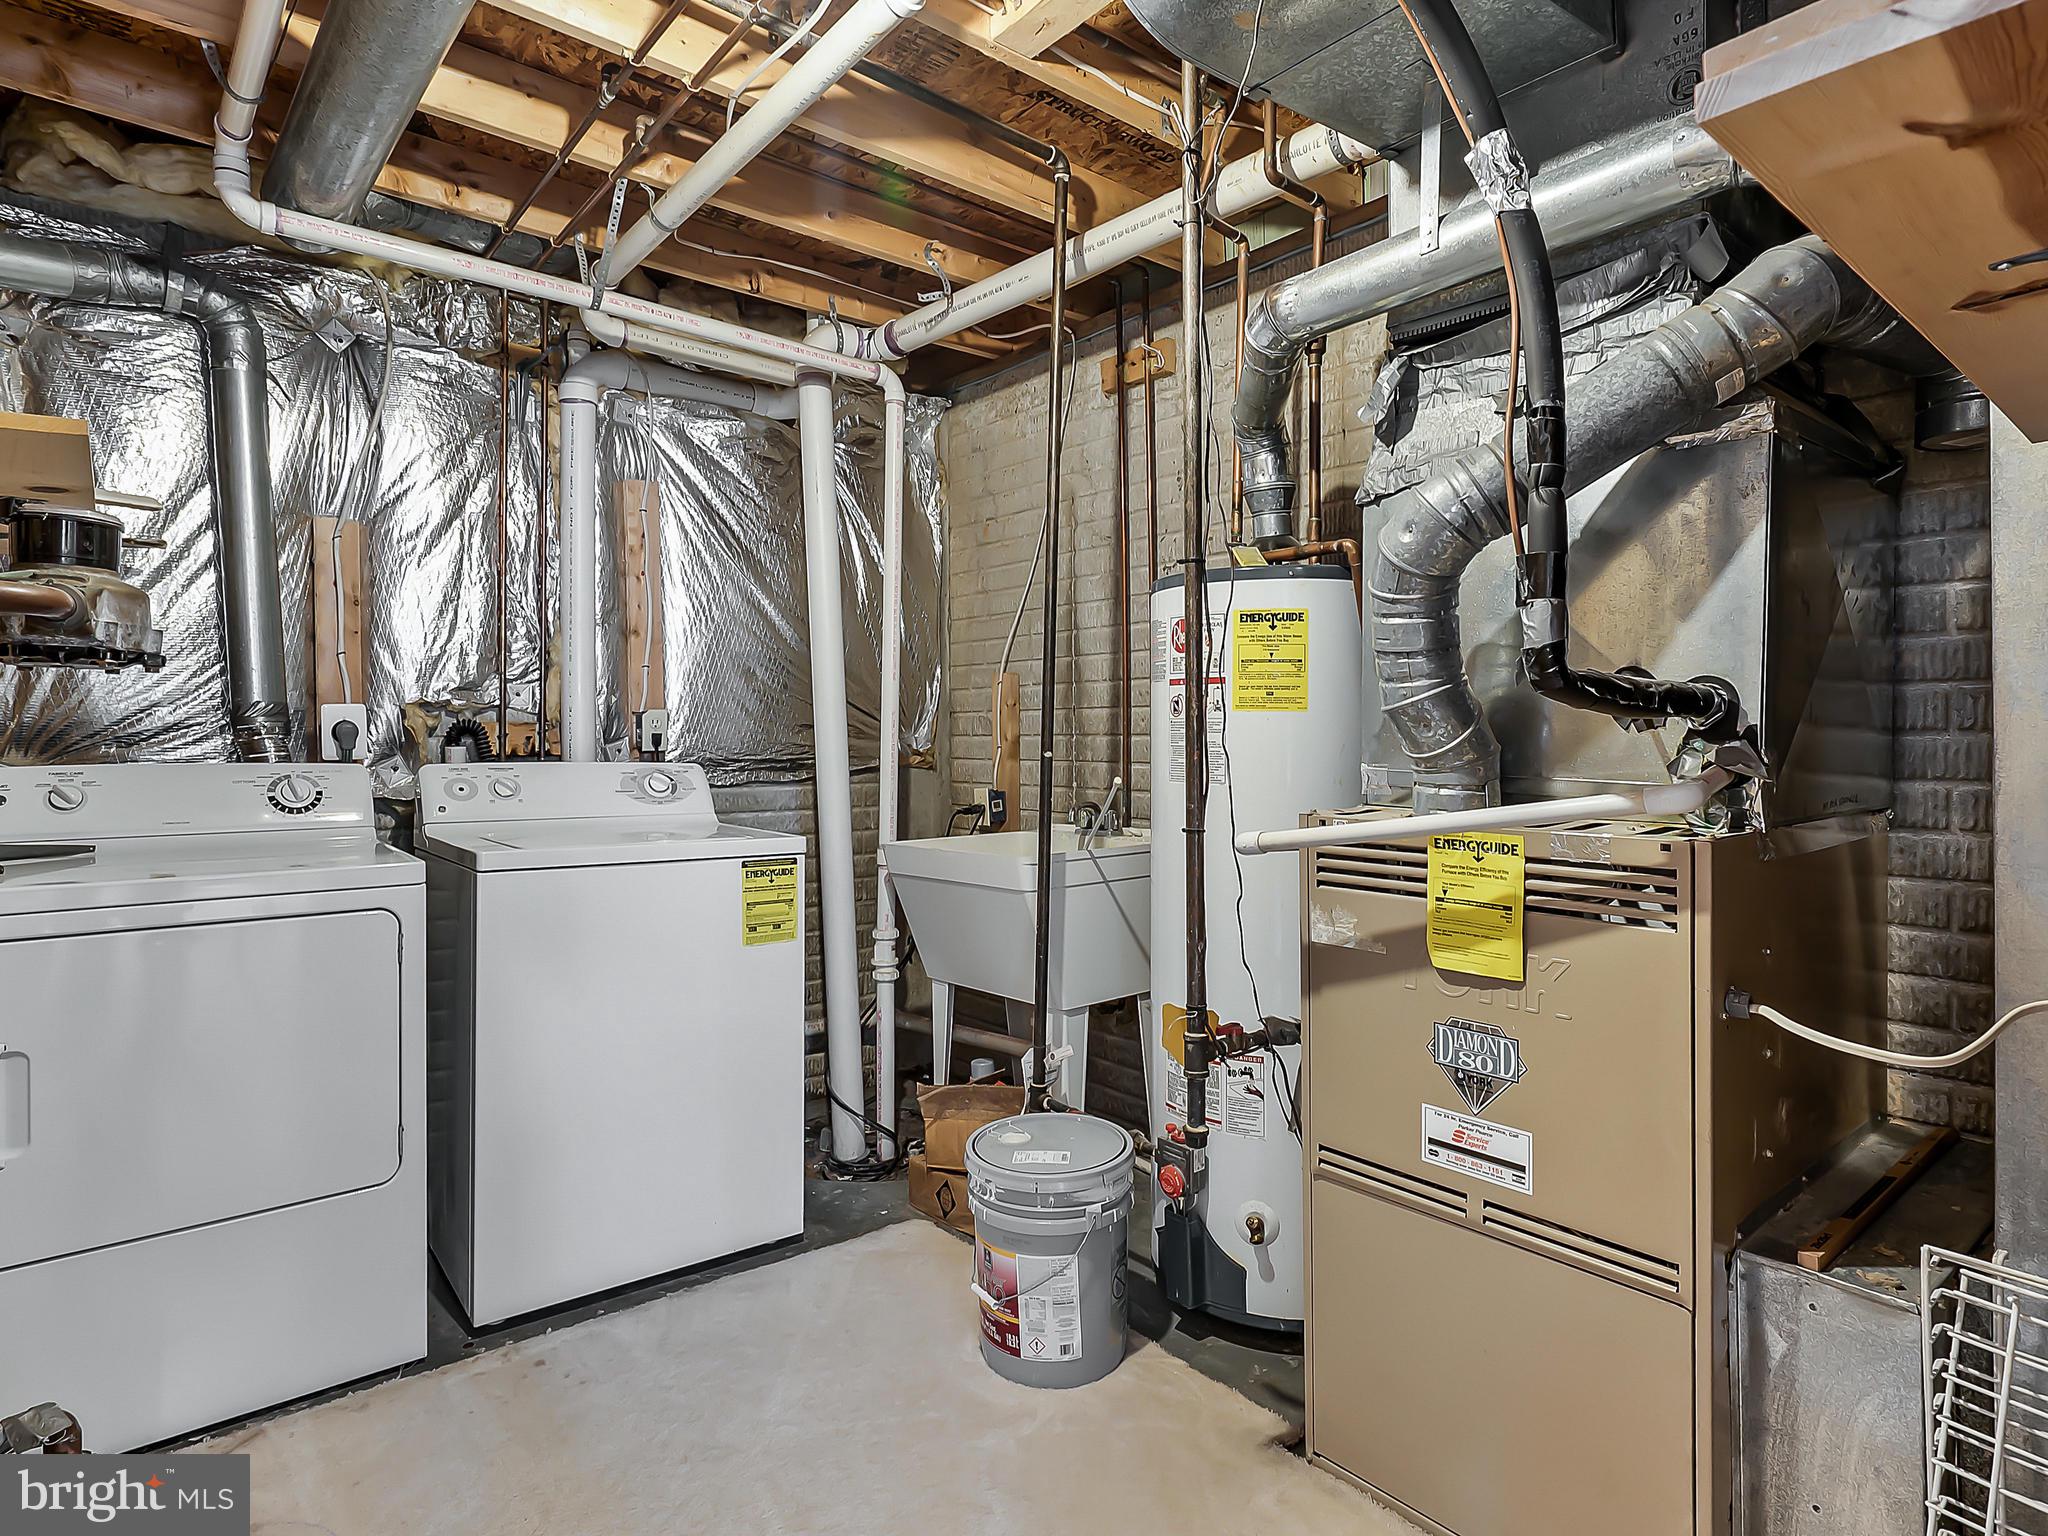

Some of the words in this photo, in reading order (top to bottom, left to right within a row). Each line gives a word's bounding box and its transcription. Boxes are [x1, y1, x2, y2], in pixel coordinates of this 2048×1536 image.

[1239, 612, 1305, 623] ENERGYGUIDE
[1433, 837, 1519, 857] ENERGYGUIDE
[745, 867, 795, 879] ENERGYGUIDE
[1441, 862, 1458, 871] Compare
[1466, 865, 1479, 873] Energy
[1479, 866, 1498, 875] Efficiency
[1441, 868, 1457, 876] Furnace
[1436, 1024, 1516, 1078] DIAMOND
[1458, 1050, 1494, 1073] 80
[1466, 1073, 1493, 1089] YORK
[1464, 1139, 1488, 1152] Experts
[1466, 1133, 1490, 1146] Service
